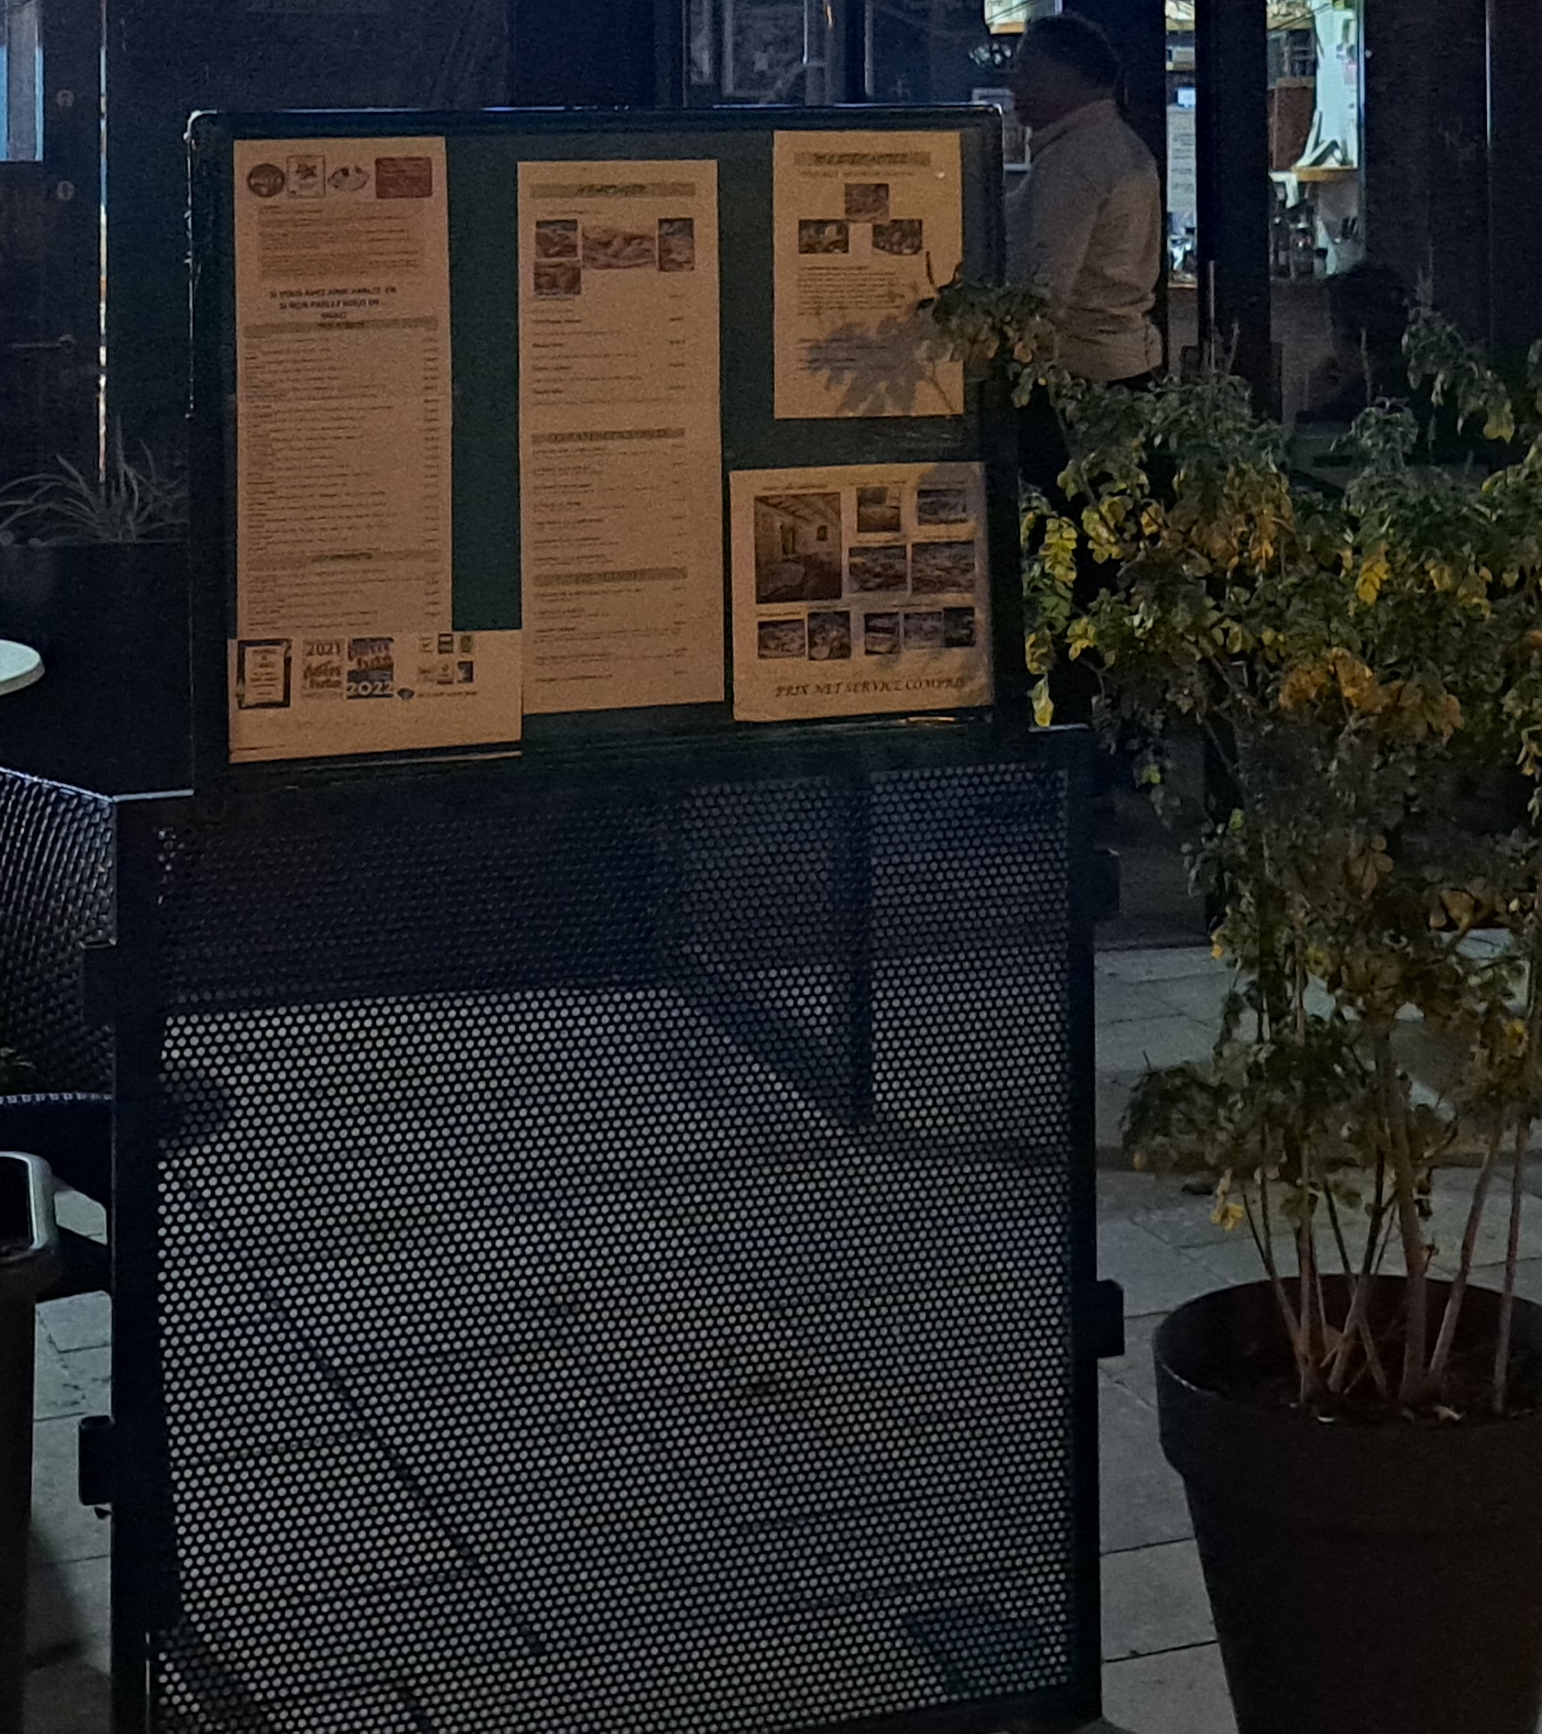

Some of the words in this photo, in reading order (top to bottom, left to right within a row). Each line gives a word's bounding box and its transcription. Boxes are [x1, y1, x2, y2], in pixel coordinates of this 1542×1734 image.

[306, 641, 342, 657] 2021
[347, 680, 393, 696] 2022
[775, 684, 810, 698] PRIX
[812, 682, 843, 696] NET
[846, 679, 903, 694] SERVICE
